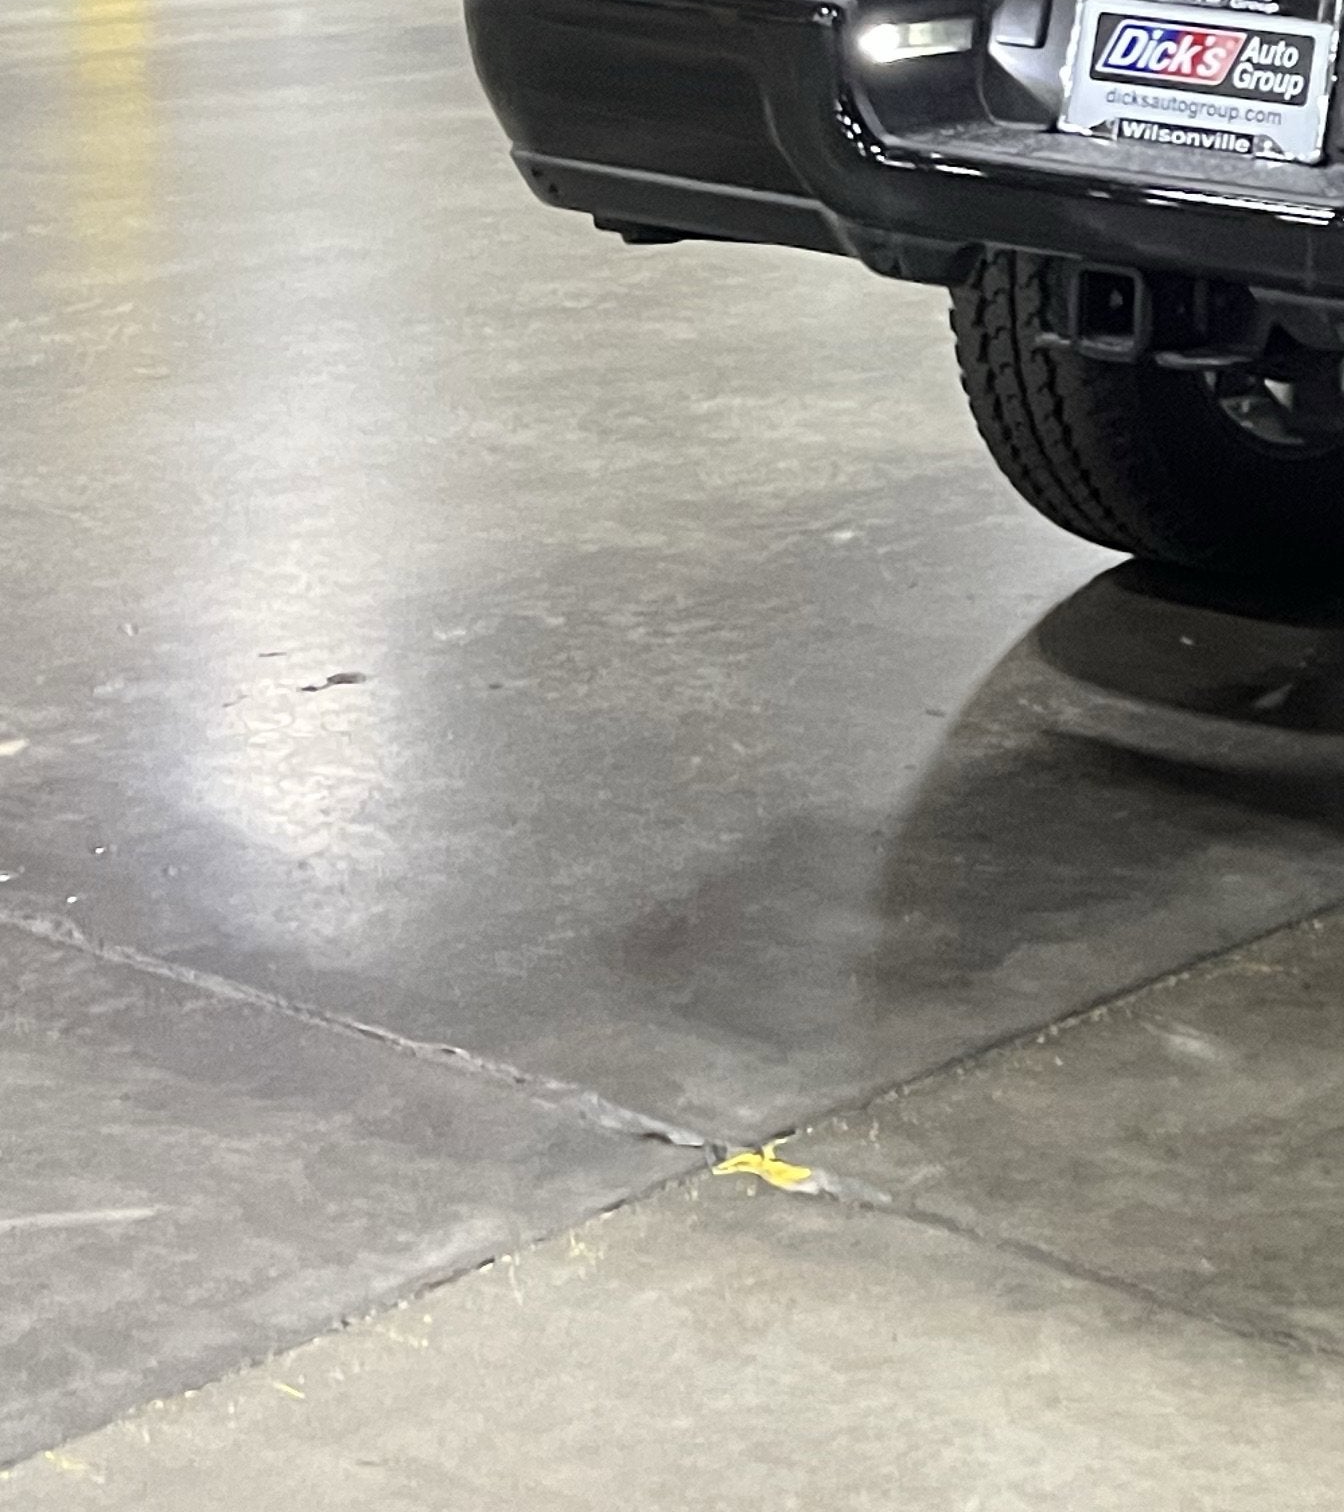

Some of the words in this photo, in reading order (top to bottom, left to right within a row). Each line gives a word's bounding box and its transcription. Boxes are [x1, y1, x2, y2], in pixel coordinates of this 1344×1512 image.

[1108, 28, 1225, 76] Dick's
[1240, 36, 1299, 68] Auto
[1232, 62, 1304, 100] Group
[1106, 88, 1282, 125] dicksautogroup.com
[1121, 120, 1250, 153] Wilsonville
